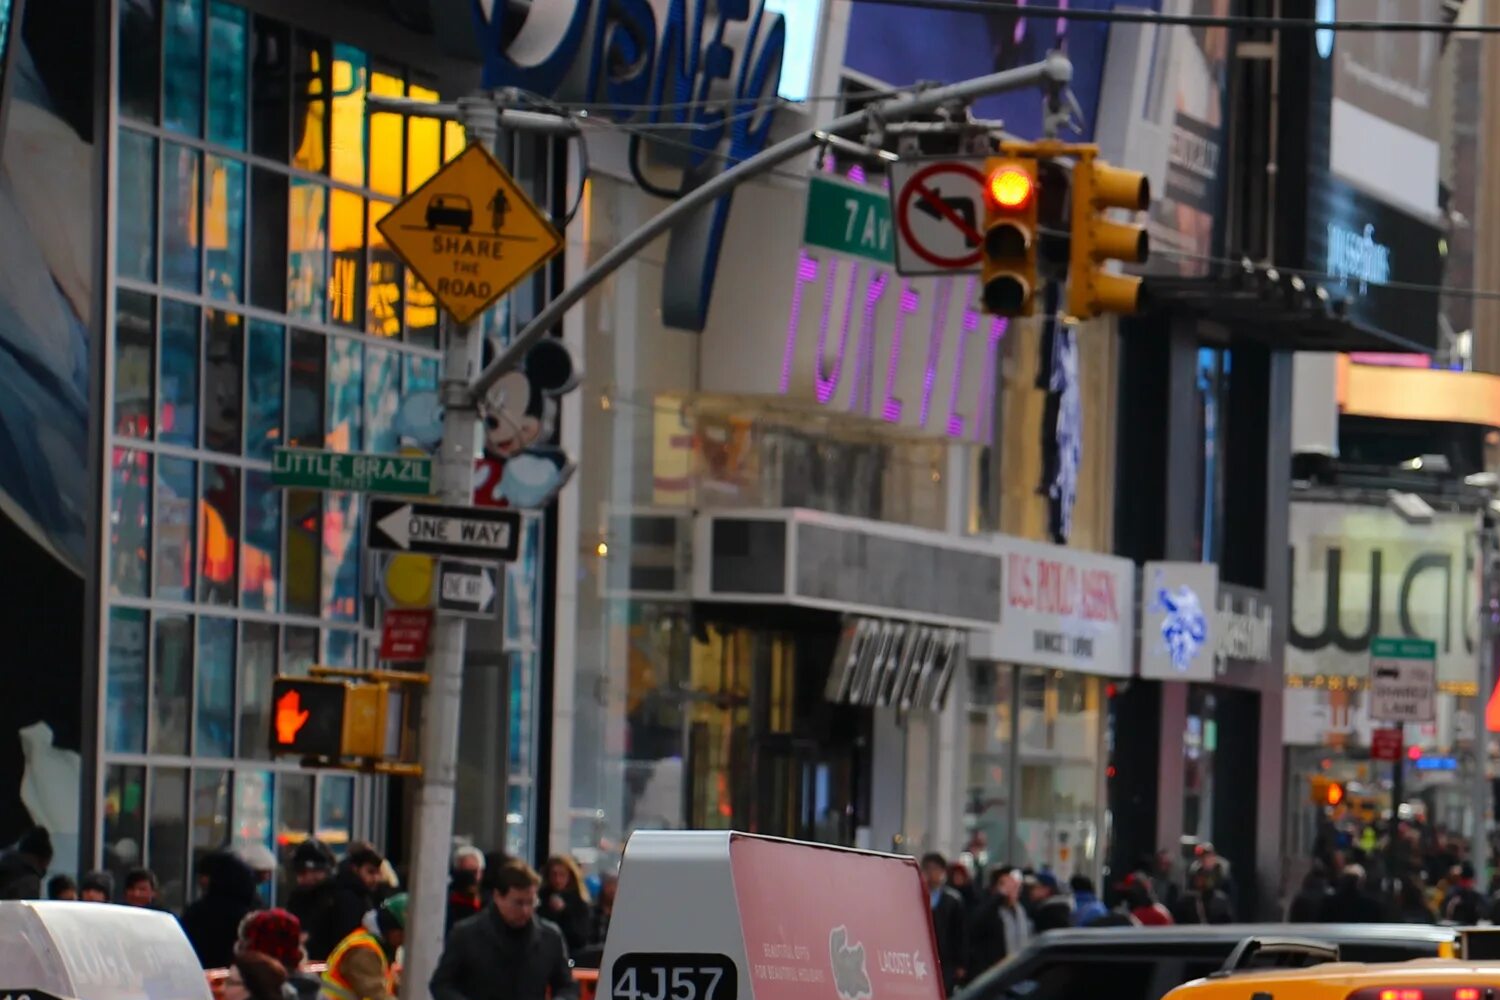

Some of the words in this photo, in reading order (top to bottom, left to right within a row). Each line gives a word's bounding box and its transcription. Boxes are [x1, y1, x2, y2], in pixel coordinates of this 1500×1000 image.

[844, 199, 859, 242] 7
[432, 235, 504, 261] SHARE
[453, 260, 480, 276] THE
[437, 277, 492, 299] ROAD
[273, 452, 343, 478] LITTLE
[352, 456, 431, 482] BRAZIL
[407, 515, 449, 541] ONE
[460, 521, 504, 545] WAY
[877, 949, 913, 977] LACOSTE
